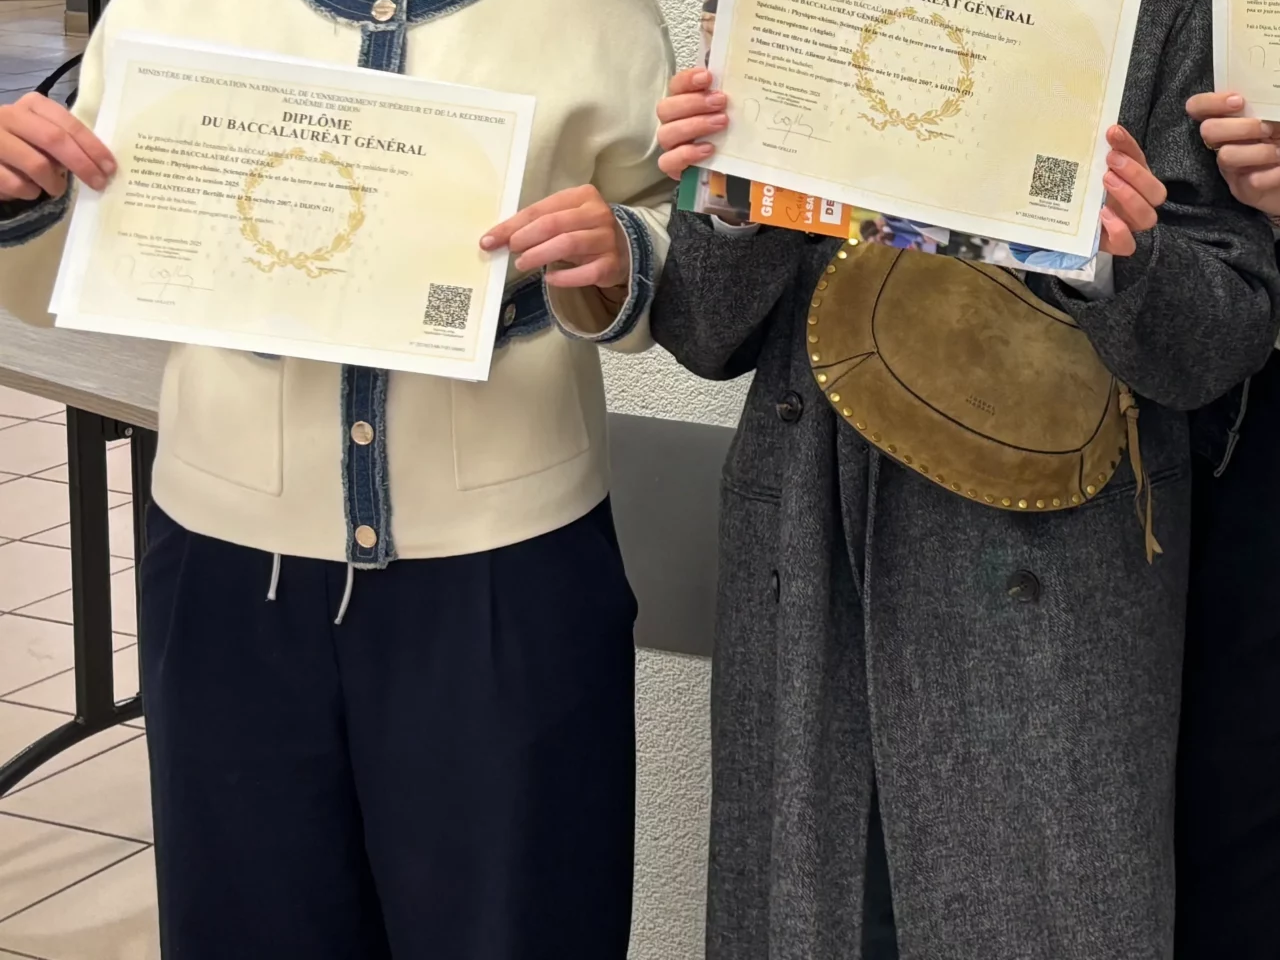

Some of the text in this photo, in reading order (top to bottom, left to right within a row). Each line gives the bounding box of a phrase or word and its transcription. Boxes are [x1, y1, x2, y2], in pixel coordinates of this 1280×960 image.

[963, 0, 1036, 26] GÉNÉRAL
[181, 73, 193, 81] DE
[446, 110, 457, 118] LA
[282, 96, 323, 108] ACADÉMIE
[325, 102, 336, 110] DE
[281, 110, 353, 131] DIPLÔME
[201, 115, 427, 156] DU BACCALAURÉAT GÉNÉRAL
[805, 194, 815, 211] SA
